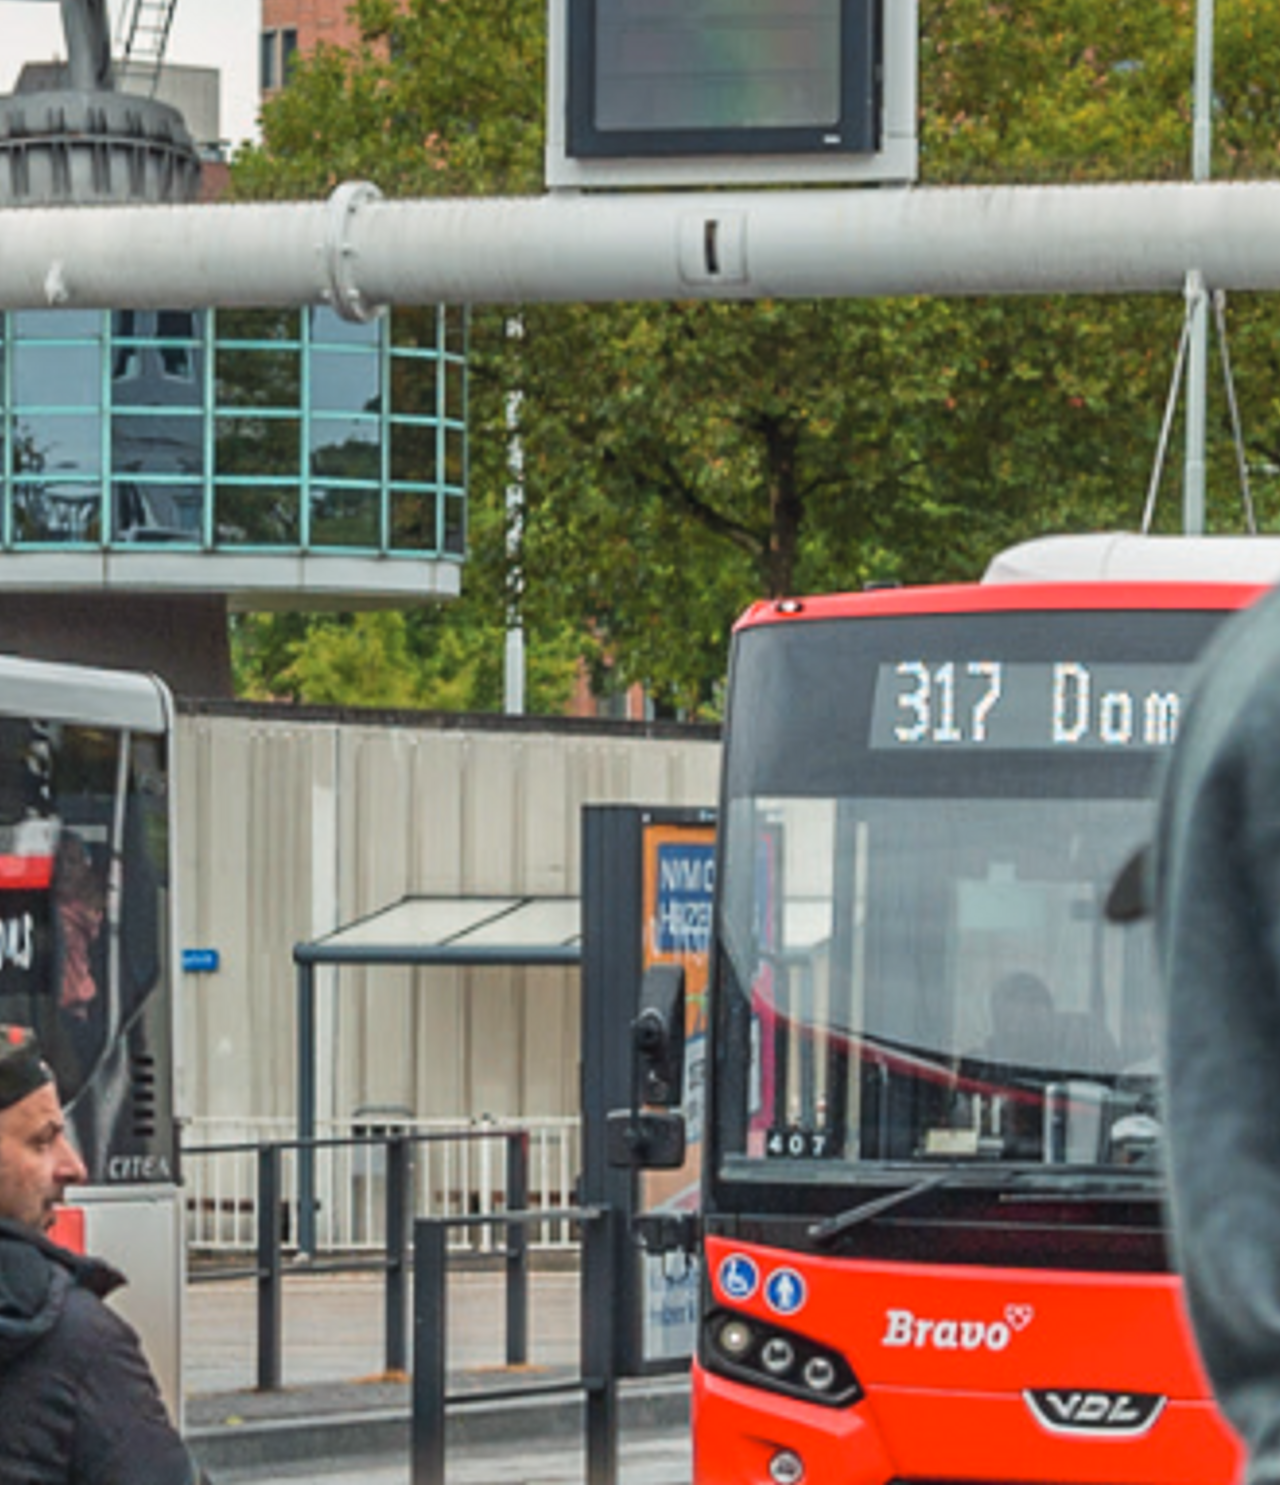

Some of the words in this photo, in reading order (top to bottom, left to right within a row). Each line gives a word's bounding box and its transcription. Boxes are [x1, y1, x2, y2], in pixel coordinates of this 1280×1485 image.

[704, 218, 720, 275] I
[894, 661, 1001, 744] 317
[1052, 661, 1180, 745] Dom
[881, 1307, 1012, 1352] Bravo
[1044, 1392, 1140, 1422] VDL
